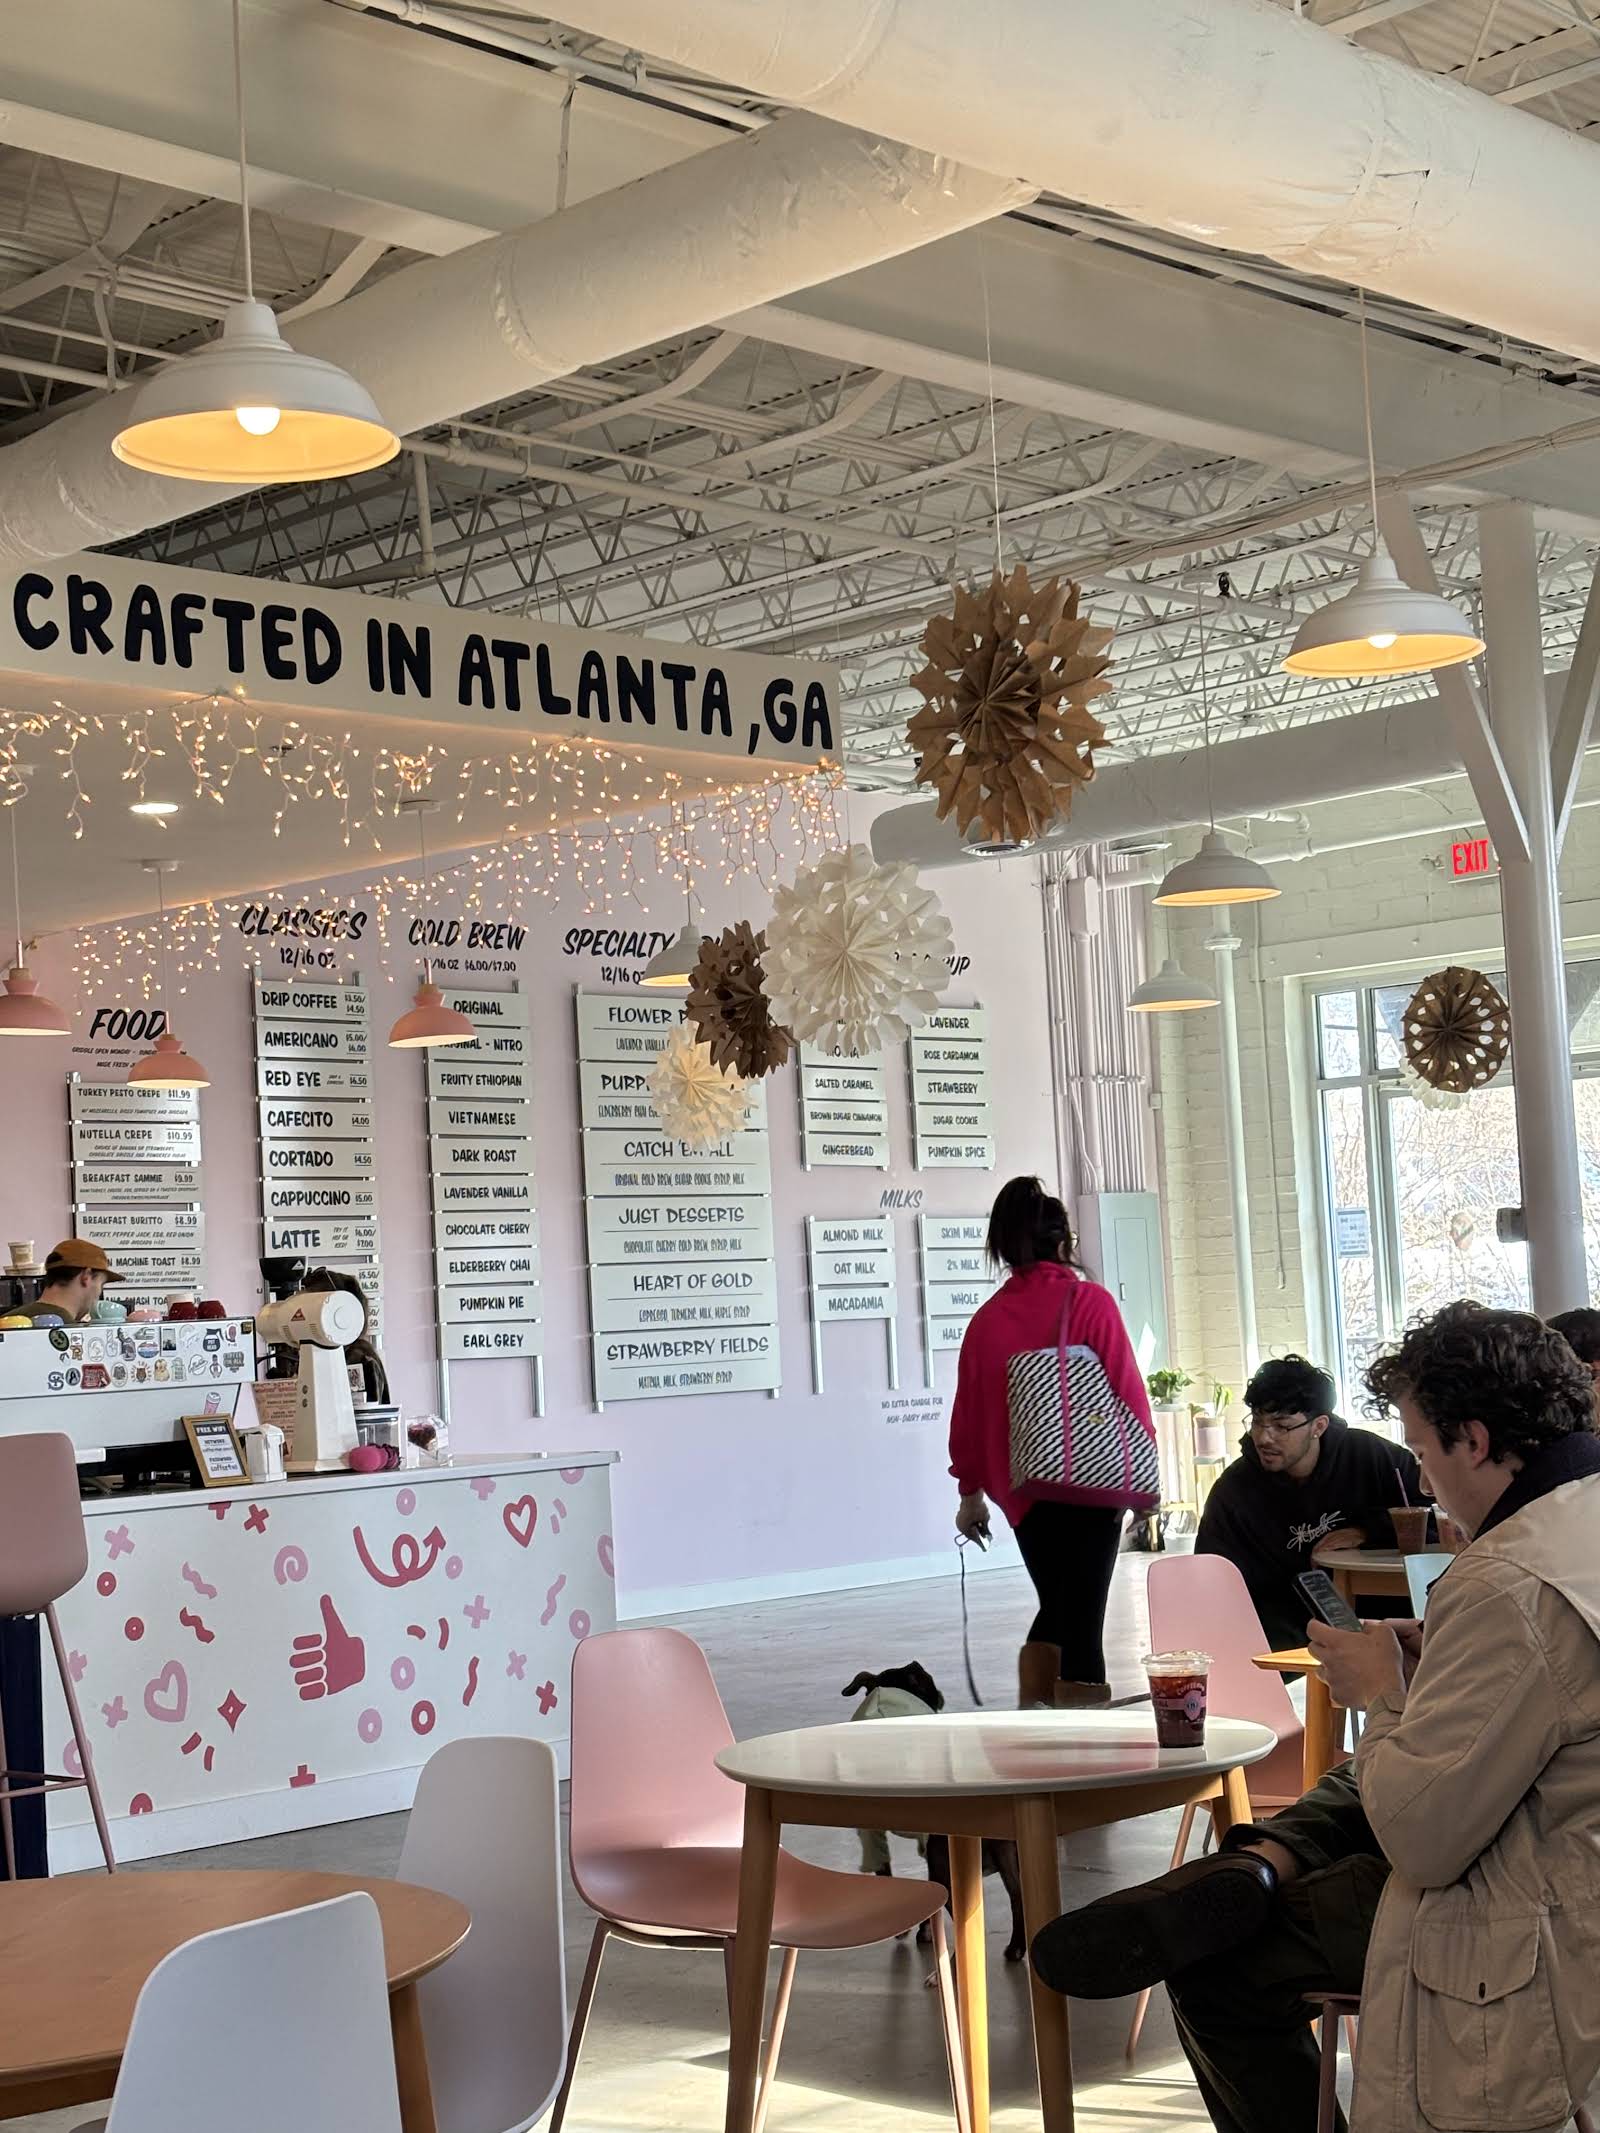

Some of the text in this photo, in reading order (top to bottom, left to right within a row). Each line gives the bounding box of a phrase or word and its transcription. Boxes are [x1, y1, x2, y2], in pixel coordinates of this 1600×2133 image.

[13, 572, 342, 685] CRAFTED
[367, 617, 432, 699] IN
[459, 633, 733, 737] ATLANTA
[1452, 840, 1488, 875] EXIT
[239, 906, 368, 940] CLASSICS
[408, 918, 526, 950] COLD BREW
[562, 927, 676, 958] SPECIALTY
[280, 948, 314, 968] 12/16
[448, 959, 459, 970] OZ
[601, 966, 630, 983] 12/16
[262, 991, 338, 1009] DRIP COFFEE
[453, 1000, 504, 1016] ORIGINAL
[609, 1007, 673, 1024] FLOWER
[89, 1009, 166, 1041] FOOD
[930, 1017, 970, 1030] LAVENDER
[265, 1031, 339, 1049] AMERICANO
[494, 1039, 523, 1052] NITRO
[616, 1038, 644, 1051] LAVENDER
[645, 1039, 666, 1051] VANILLA
[95, 1047, 109, 1055] OPEN
[110, 1047, 131, 1055] MONDAY
[924, 1050, 979, 1061] ROSE CARDAMOM
[265, 1070, 321, 1088] RED EYE
[350, 1077, 368, 1086] $6.50
[441, 1073, 523, 1087] FRUITY ETHIOPIAN
[815, 1079, 874, 1090] SALTED CARAMEL
[78, 1089, 191, 1100] TURKEY PESTO CREPE $11.99
[927, 1082, 978, 1094] STRAWBERRY
[449, 1111, 516, 1126] VIETNAMESE
[598, 1105, 633, 1118] ELDERBERRY
[810, 1111, 882, 1123] BROWN SUGAR CINNAMON
[267, 1110, 333, 1128] CAFECITO
[352, 1116, 370, 1125] $4.00
[933, 1115, 978, 1125] SUGAR COOKIE
[80, 1130, 193, 1141] NUTELLA CREPE $10.99
[452, 1149, 517, 1163] DARK ROAST
[624, 1141, 673, 1158] CATCH
[822, 1145, 874, 1157] GINGERBREAD
[928, 1146, 986, 1158] PUMPKIN SPICE
[269, 1150, 334, 1167] CORTADO
[355, 1155, 372, 1164] $4.50
[83, 1174, 193, 1183] BREAKFAST SAMMIE $9.99
[615, 1173, 640, 1187] ORIGINAL
[642, 1173, 656, 1186] COLD
[675, 1173, 693, 1186] SUGAR
[733, 1173, 745, 1185] MILK
[271, 1190, 351, 1207] CAPPUCCINO
[355, 1194, 373, 1203] $5.00
[444, 1186, 529, 1200] LAVENDER VANILLA
[880, 1189, 923, 1209] MILKS
[83, 1217, 198, 1226] BREAKFAST BURITTO $8.99
[619, 1207, 745, 1224] JUST DESSERTS
[355, 1229, 376, 1239] $6.00/
[446, 1223, 531, 1236] CHOCOLATE CHERRY
[823, 1228, 884, 1242] ALMOND MILK
[941, 1227, 983, 1240] SKIM MILK
[272, 1230, 321, 1250] LATTE
[624, 1240, 654, 1254] CHOCOLATE
[656, 1240, 677, 1253] CHERRY
[679, 1239, 693, 1252] COLD
[730, 1238, 742, 1251] MILK
[116, 1257, 149, 1267] MACHINE
[152, 1257, 176, 1267] TOAST
[181, 1257, 201, 1266] $8.99
[450, 1260, 531, 1274] ELDERBERRY CHAI
[834, 1262, 876, 1275] OAT MILK
[947, 1258, 980, 1271] 2% MILK
[359, 1271, 380, 1279] $5.50/
[362, 1282, 379, 1290] $6.50
[633, 1273, 753, 1292] HEART OF GOLD
[459, 1296, 525, 1312] PUMPKIN PIE
[828, 1296, 884, 1312] MACADAMIA
[951, 1293, 979, 1305] WHOLE
[715, 1306, 732, 1319] MAPLE
[734, 1305, 751, 1319] SYRUP
[463, 1334, 525, 1349] EARL GREY
[942, 1328, 963, 1341] HALF
[607, 1337, 769, 1361] STRAWBERRY FIELDS
[680, 1372, 715, 1387] STRAWBERRY
[716, 1371, 733, 1384] SYRUP
[881, 1397, 943, 1409] NO EXTRA CHARGE FOR
[886, 1414, 920, 1425] NON-DAIRY
